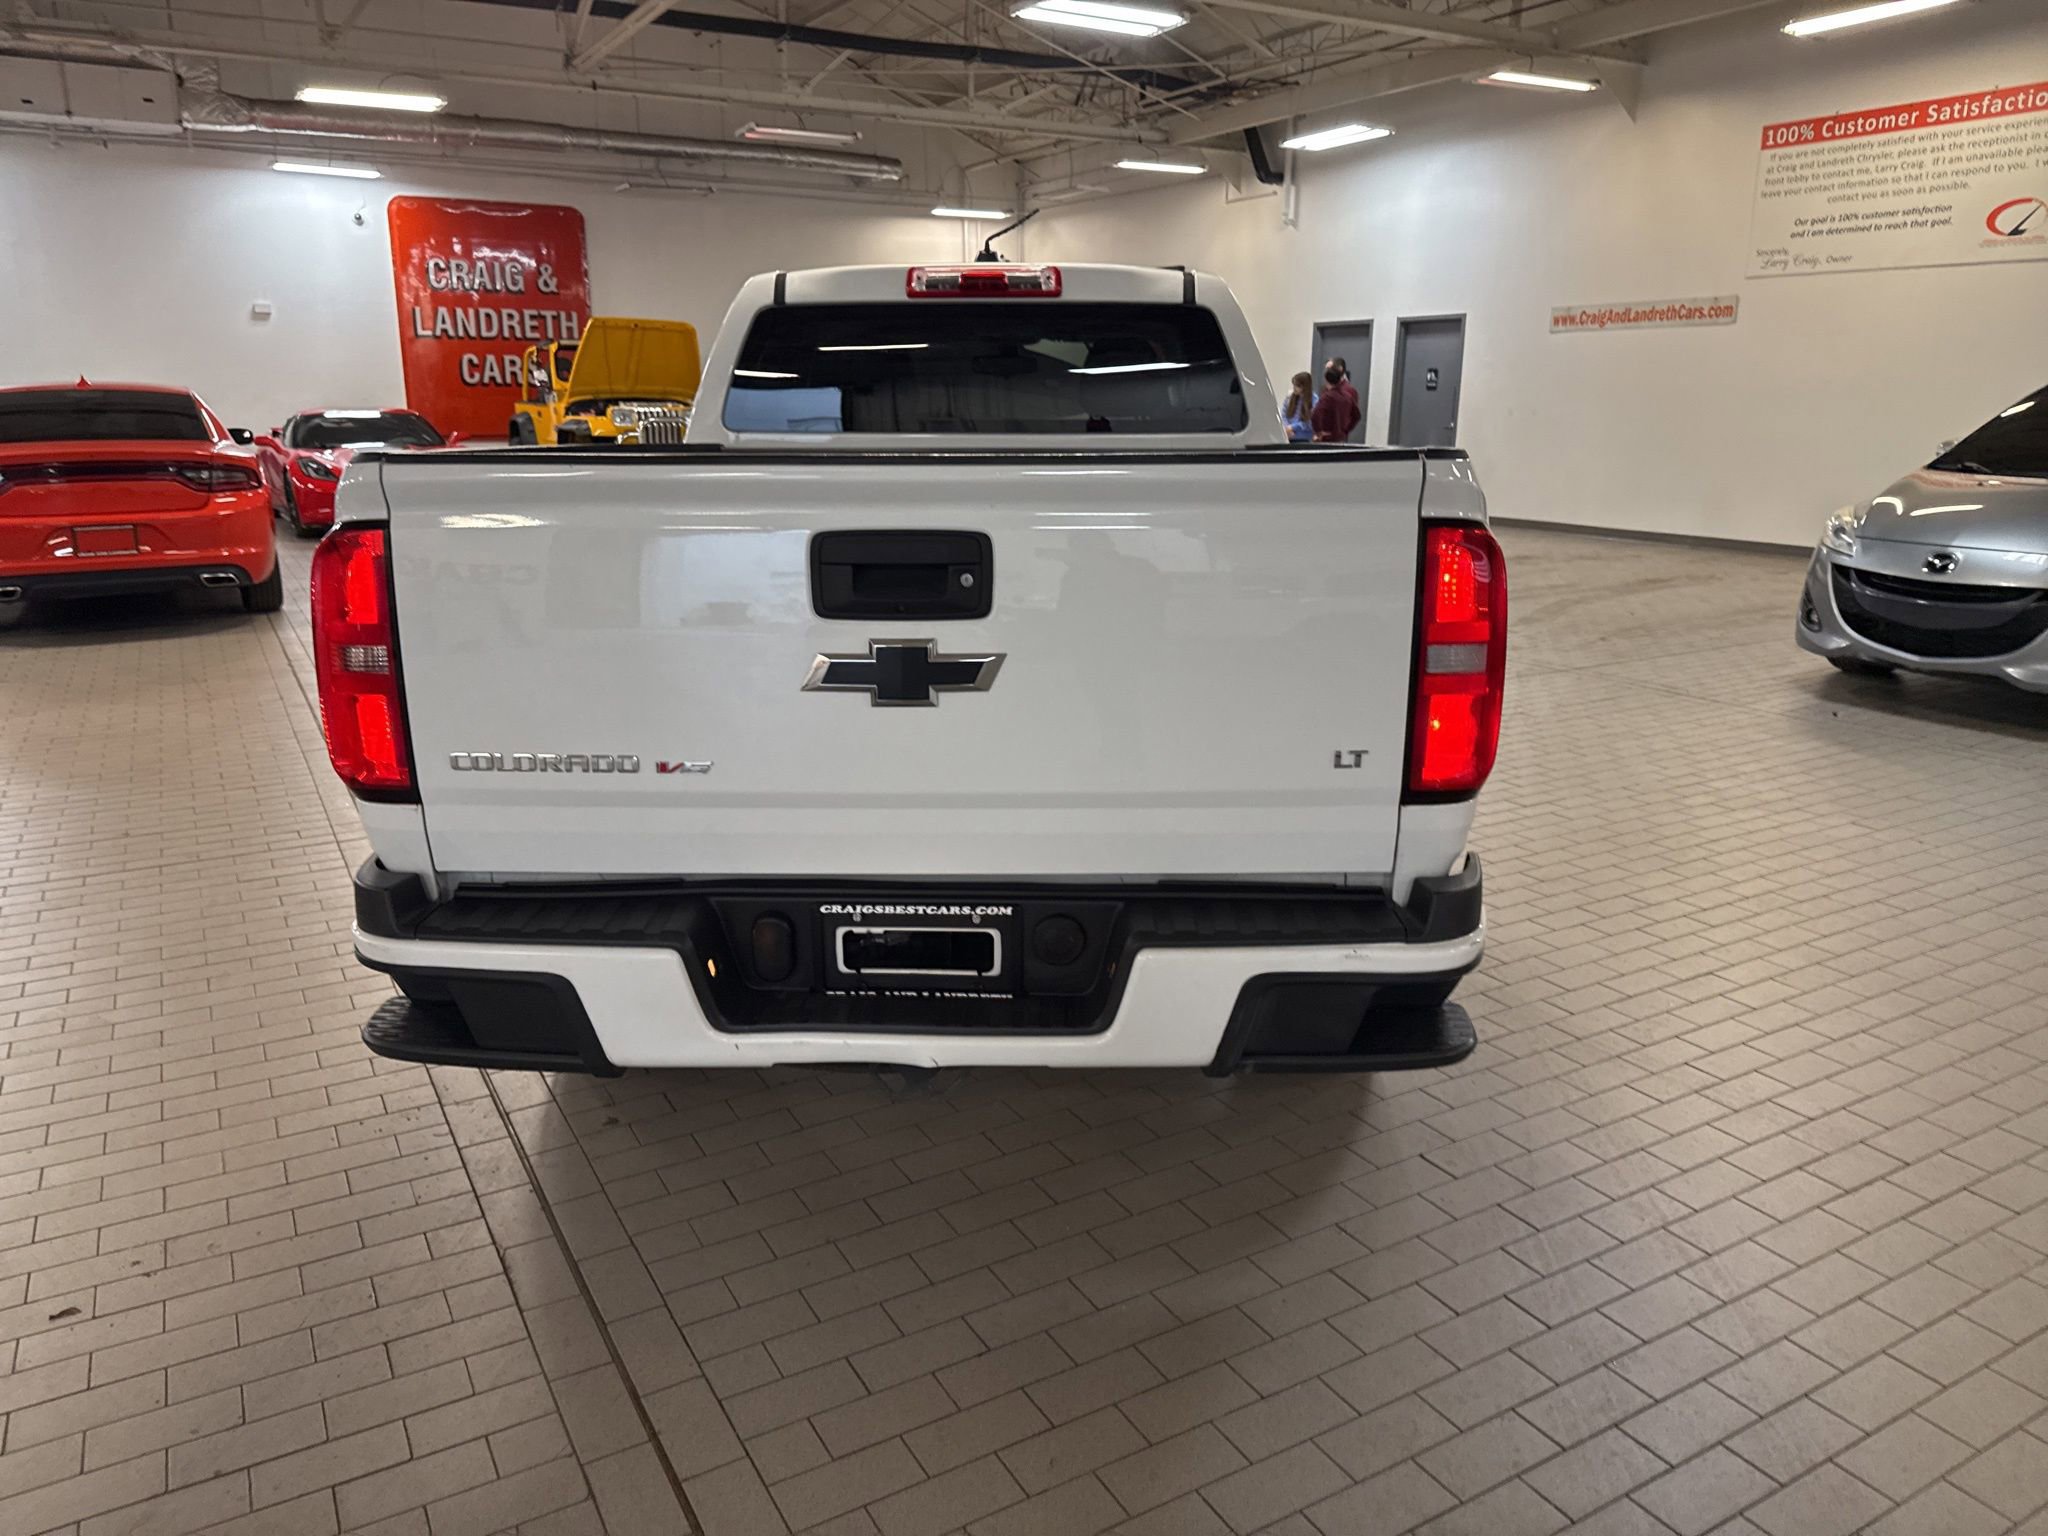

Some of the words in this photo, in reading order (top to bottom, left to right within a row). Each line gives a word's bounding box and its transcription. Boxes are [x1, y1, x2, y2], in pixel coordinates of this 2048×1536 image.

[1766, 122, 1815, 146] 100%
[1822, 110, 1920, 138] Customer
[1766, 165, 1775, 175] at
[1777, 162, 1798, 174] Craig
[1800, 160, 1815, 171] and
[1817, 155, 1855, 168] Landreth
[1857, 149, 1895, 164] Chrysler,
[1897, 146, 1928, 160] please
[1930, 143, 1946, 154] ask
[1948, 140, 1965, 151] the
[1967, 131, 2028, 149] receptionist
[2031, 130, 2041, 140] in
[1778, 152, 1794, 162] you
[1796, 149, 1809, 158] are
[1810, 147, 1825, 157] not
[1827, 140, 1875, 156] completely
[1877, 134, 1915, 148] satisfied
[1919, 131, 1939, 142] with
[1941, 129, 1964, 141] your
[1966, 122, 2001, 136] service
[1764, 176, 1785, 187] front
[1787, 173, 1809, 185] lobby
[1811, 172, 1821, 181] to
[1822, 167, 1854, 180] contact
[1875, 161, 1898, 173] Larry
[1948, 154, 1963, 164] am
[1966, 146, 2025, 162] unavailable
[1761, 190, 1782, 199] leave
[1783, 187, 1802, 199] your
[1804, 183, 1836, 195] contact
[1837, 176, 1889, 191] information
[1891, 174, 1902, 184] so
[1904, 172, 1924, 183] that
[1931, 169, 1948, 180] can
[1950, 163, 1991, 179] respond
[1994, 162, 2005, 173] to
[1827, 192, 1859, 205] contact
[1861, 190, 1878, 202] you
[1880, 189, 1890, 199] as
[1892, 185, 1915, 197] soon
[1916, 184, 1927, 194] as
[1928, 179, 1970, 195] possible.
[1790, 228, 1806, 240] and
[1811, 228, 1824, 238] am
[1825, 223, 1873, 237] determined
[1874, 222, 1883, 232] to
[1884, 220, 1908, 231] reach
[1910, 217, 1929, 229] that
[1794, 216, 1809, 228] Our
[1811, 214, 1829, 228] goal
[1830, 214, 1836, 223] is
[1838, 212, 1860, 223] 100%
[1861, 208, 1901, 221] customer
[1902, 203, 1953, 218] satisfaction
[1825, 254, 1853, 264] Owner
[427, 257, 525, 292] CRAIG
[537, 264, 559, 293] &
[413, 306, 580, 341] LANDRETH
[1553, 303, 1735, 328] www.CraigAndLandrethCars.com
[449, 751, 641, 774] COLORADO
[1333, 749, 1369, 769] LT
[819, 904, 1013, 917] CRAIGSBESTCARS.COM
